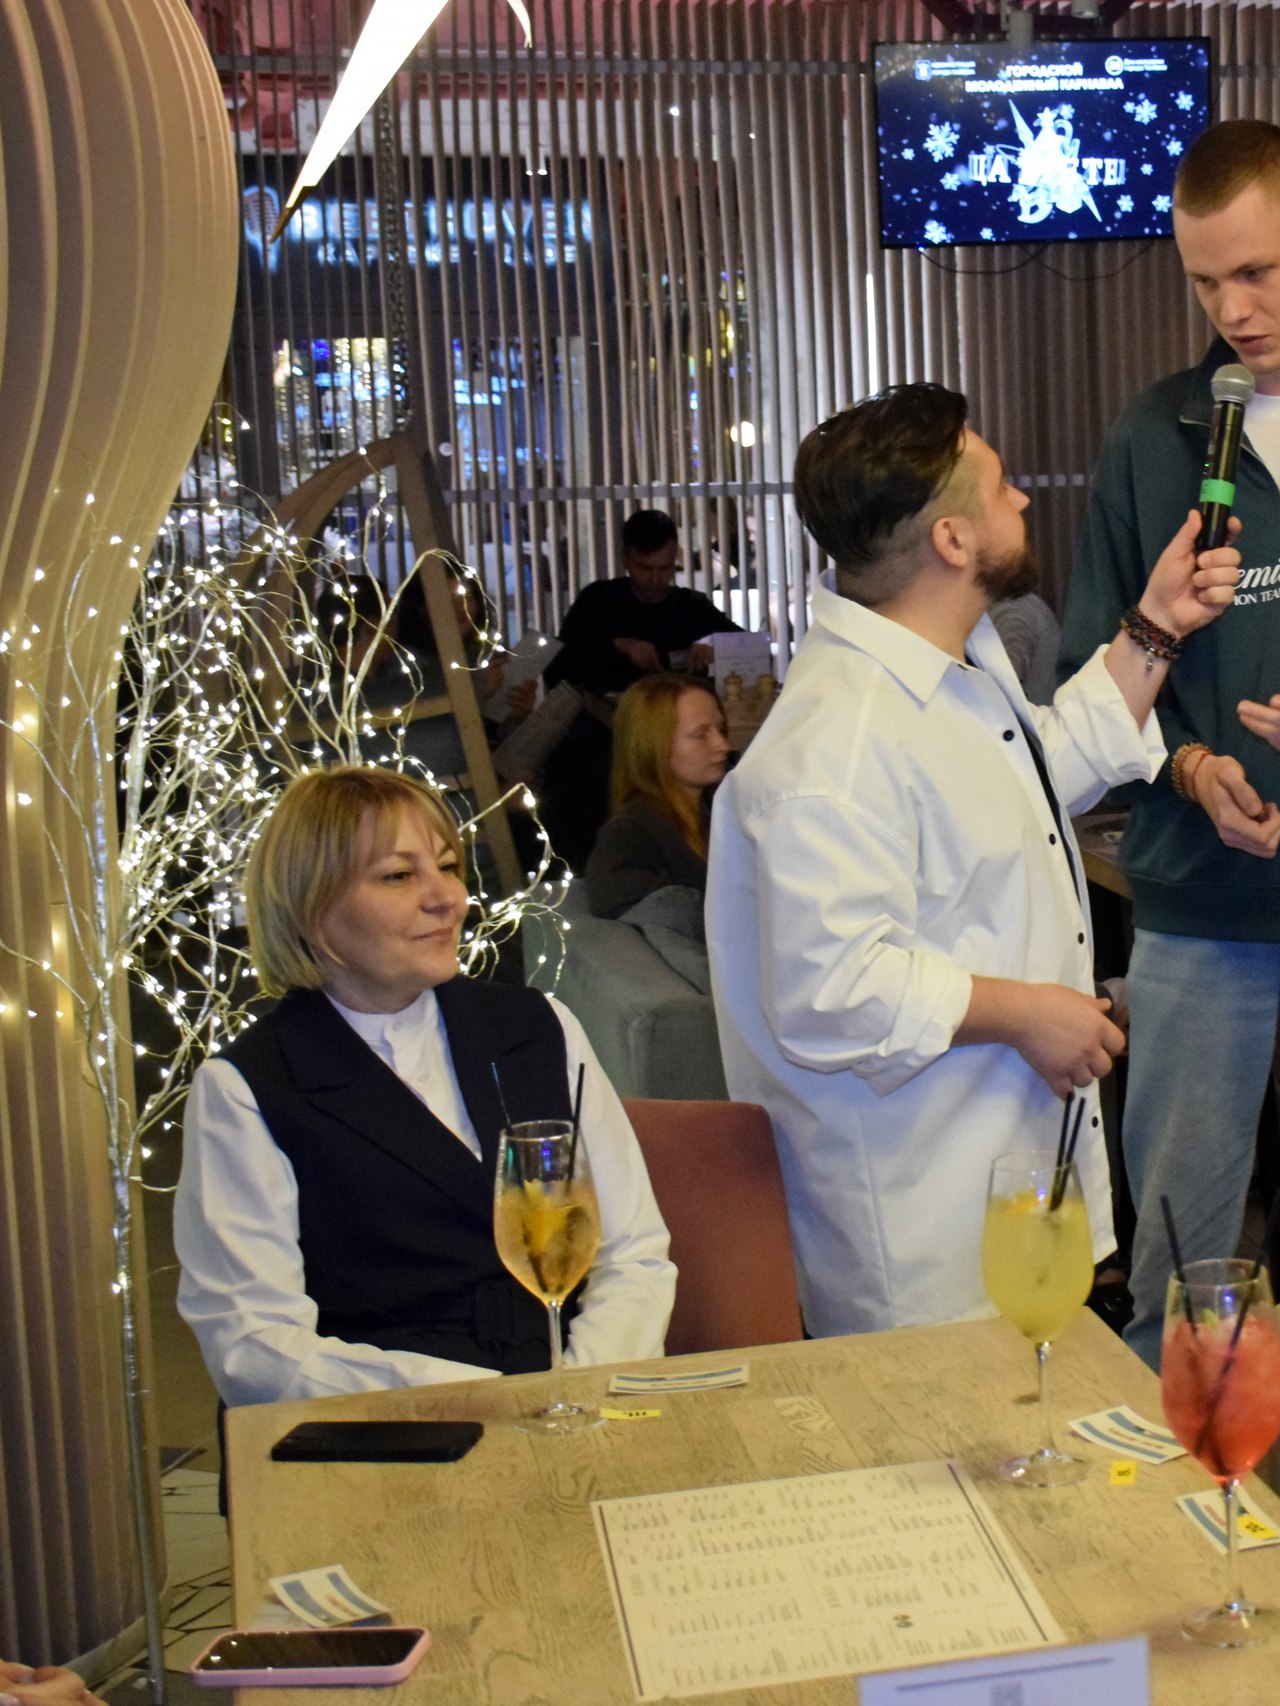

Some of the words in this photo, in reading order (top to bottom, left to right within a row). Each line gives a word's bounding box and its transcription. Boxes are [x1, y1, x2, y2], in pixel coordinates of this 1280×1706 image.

[1006, 62, 1083, 78] ГОРОДСКОЙ
[1060, 77, 1124, 91] КАРНАВАЛ
[1233, 593, 1258, 606] ION
